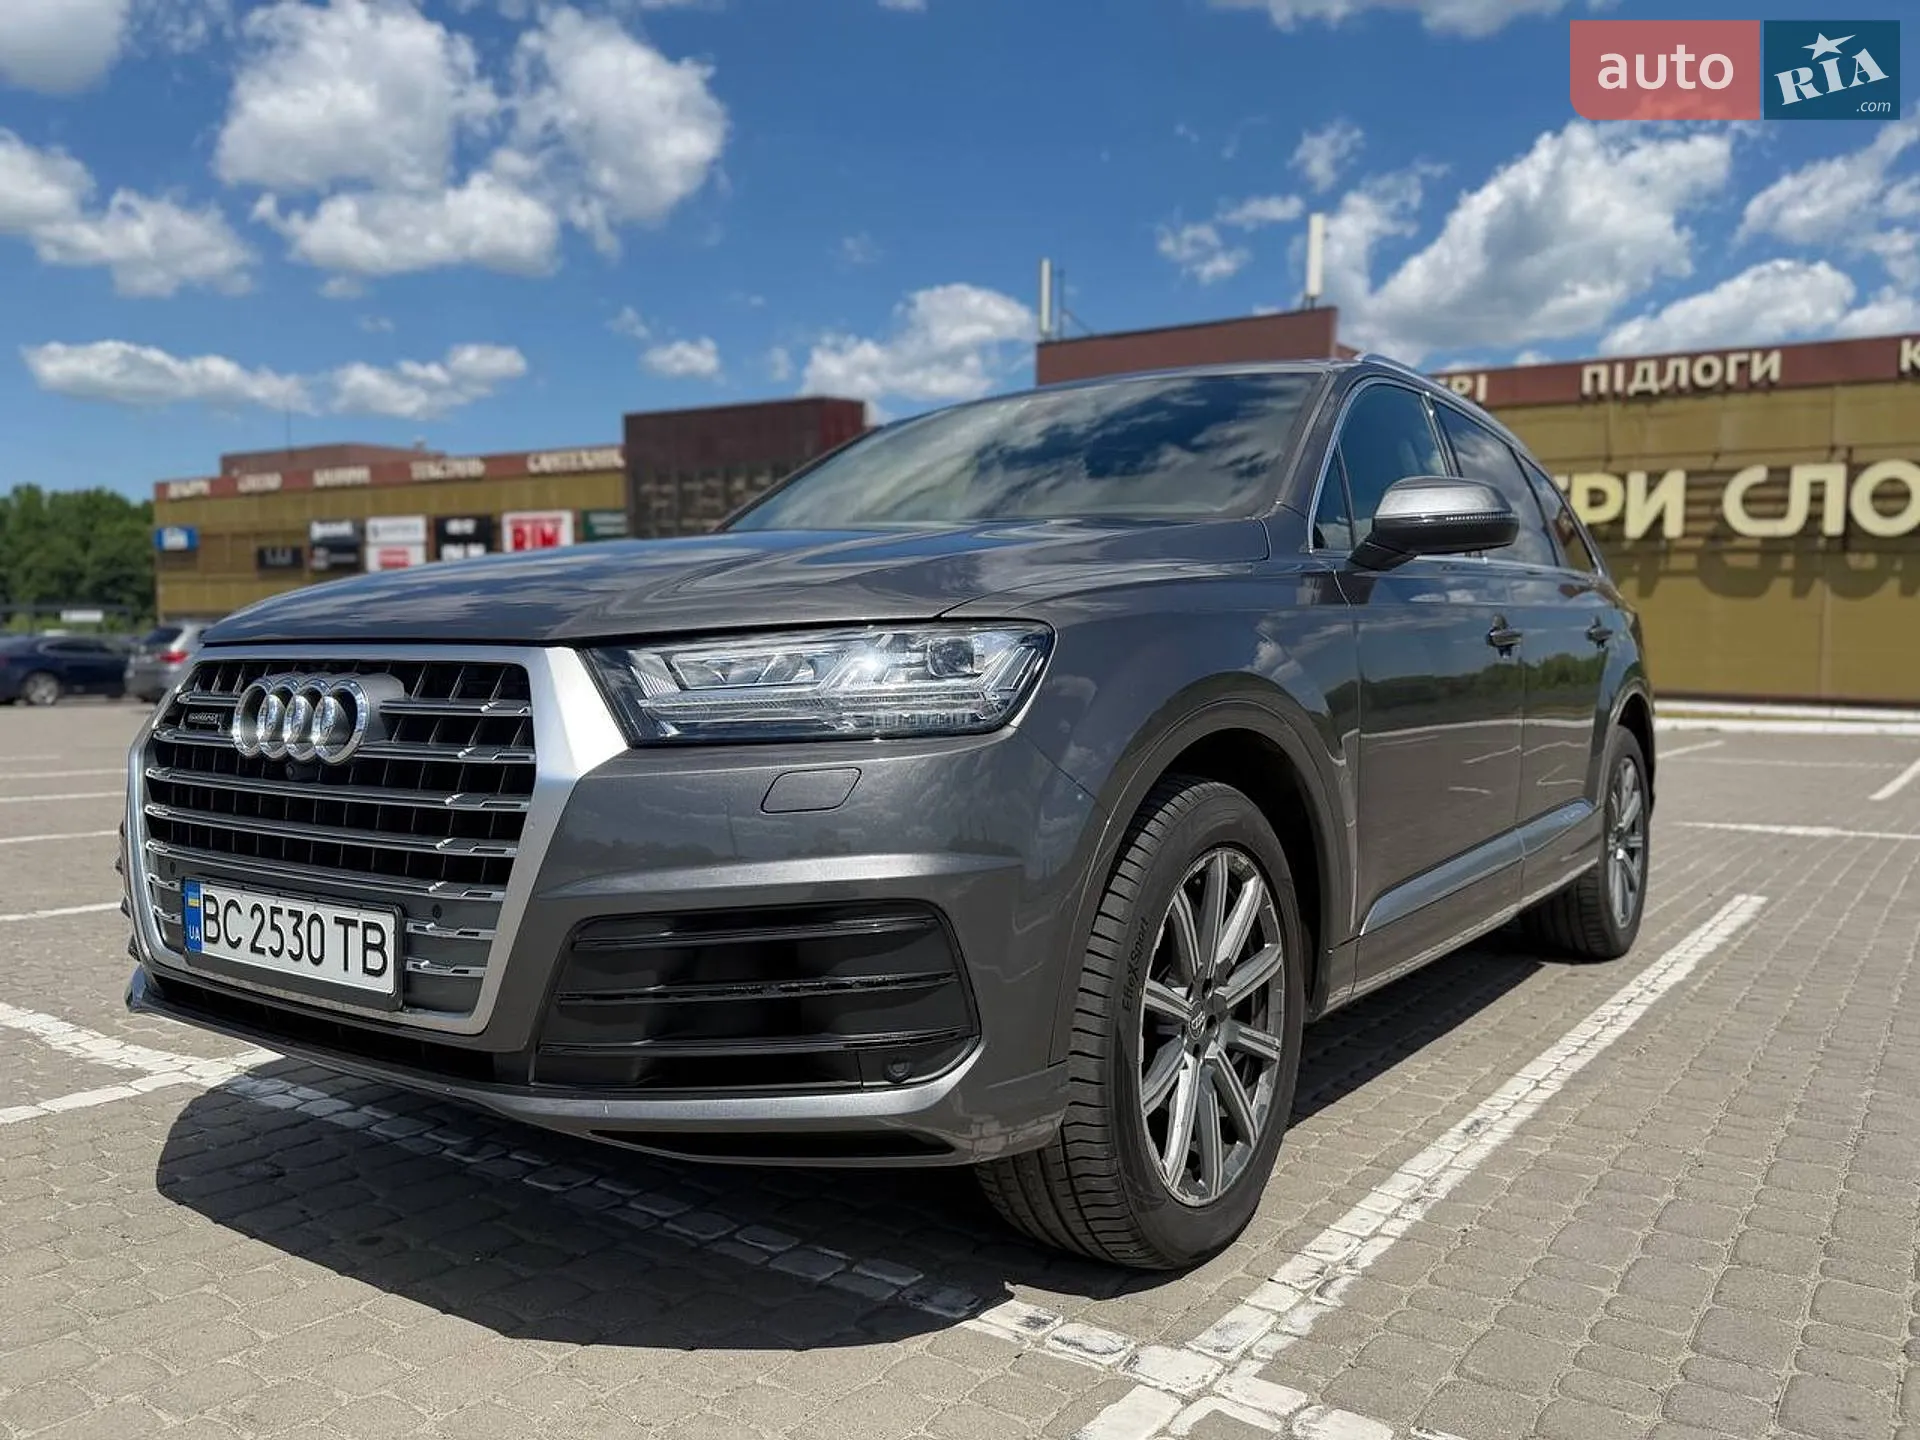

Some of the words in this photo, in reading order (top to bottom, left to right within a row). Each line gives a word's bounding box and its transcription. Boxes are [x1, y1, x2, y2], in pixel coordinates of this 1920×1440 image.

[1438, 373, 1488, 402] РІ
[1581, 349, 1782, 397] ПІДЛОГИ
[1552, 469, 1687, 539] РИ
[1721, 459, 1920, 538] СЛО
[188, 923, 200, 941] UA
[202, 893, 243, 950] BC
[250, 902, 326, 966] 2530
[333, 915, 389, 978] TB
